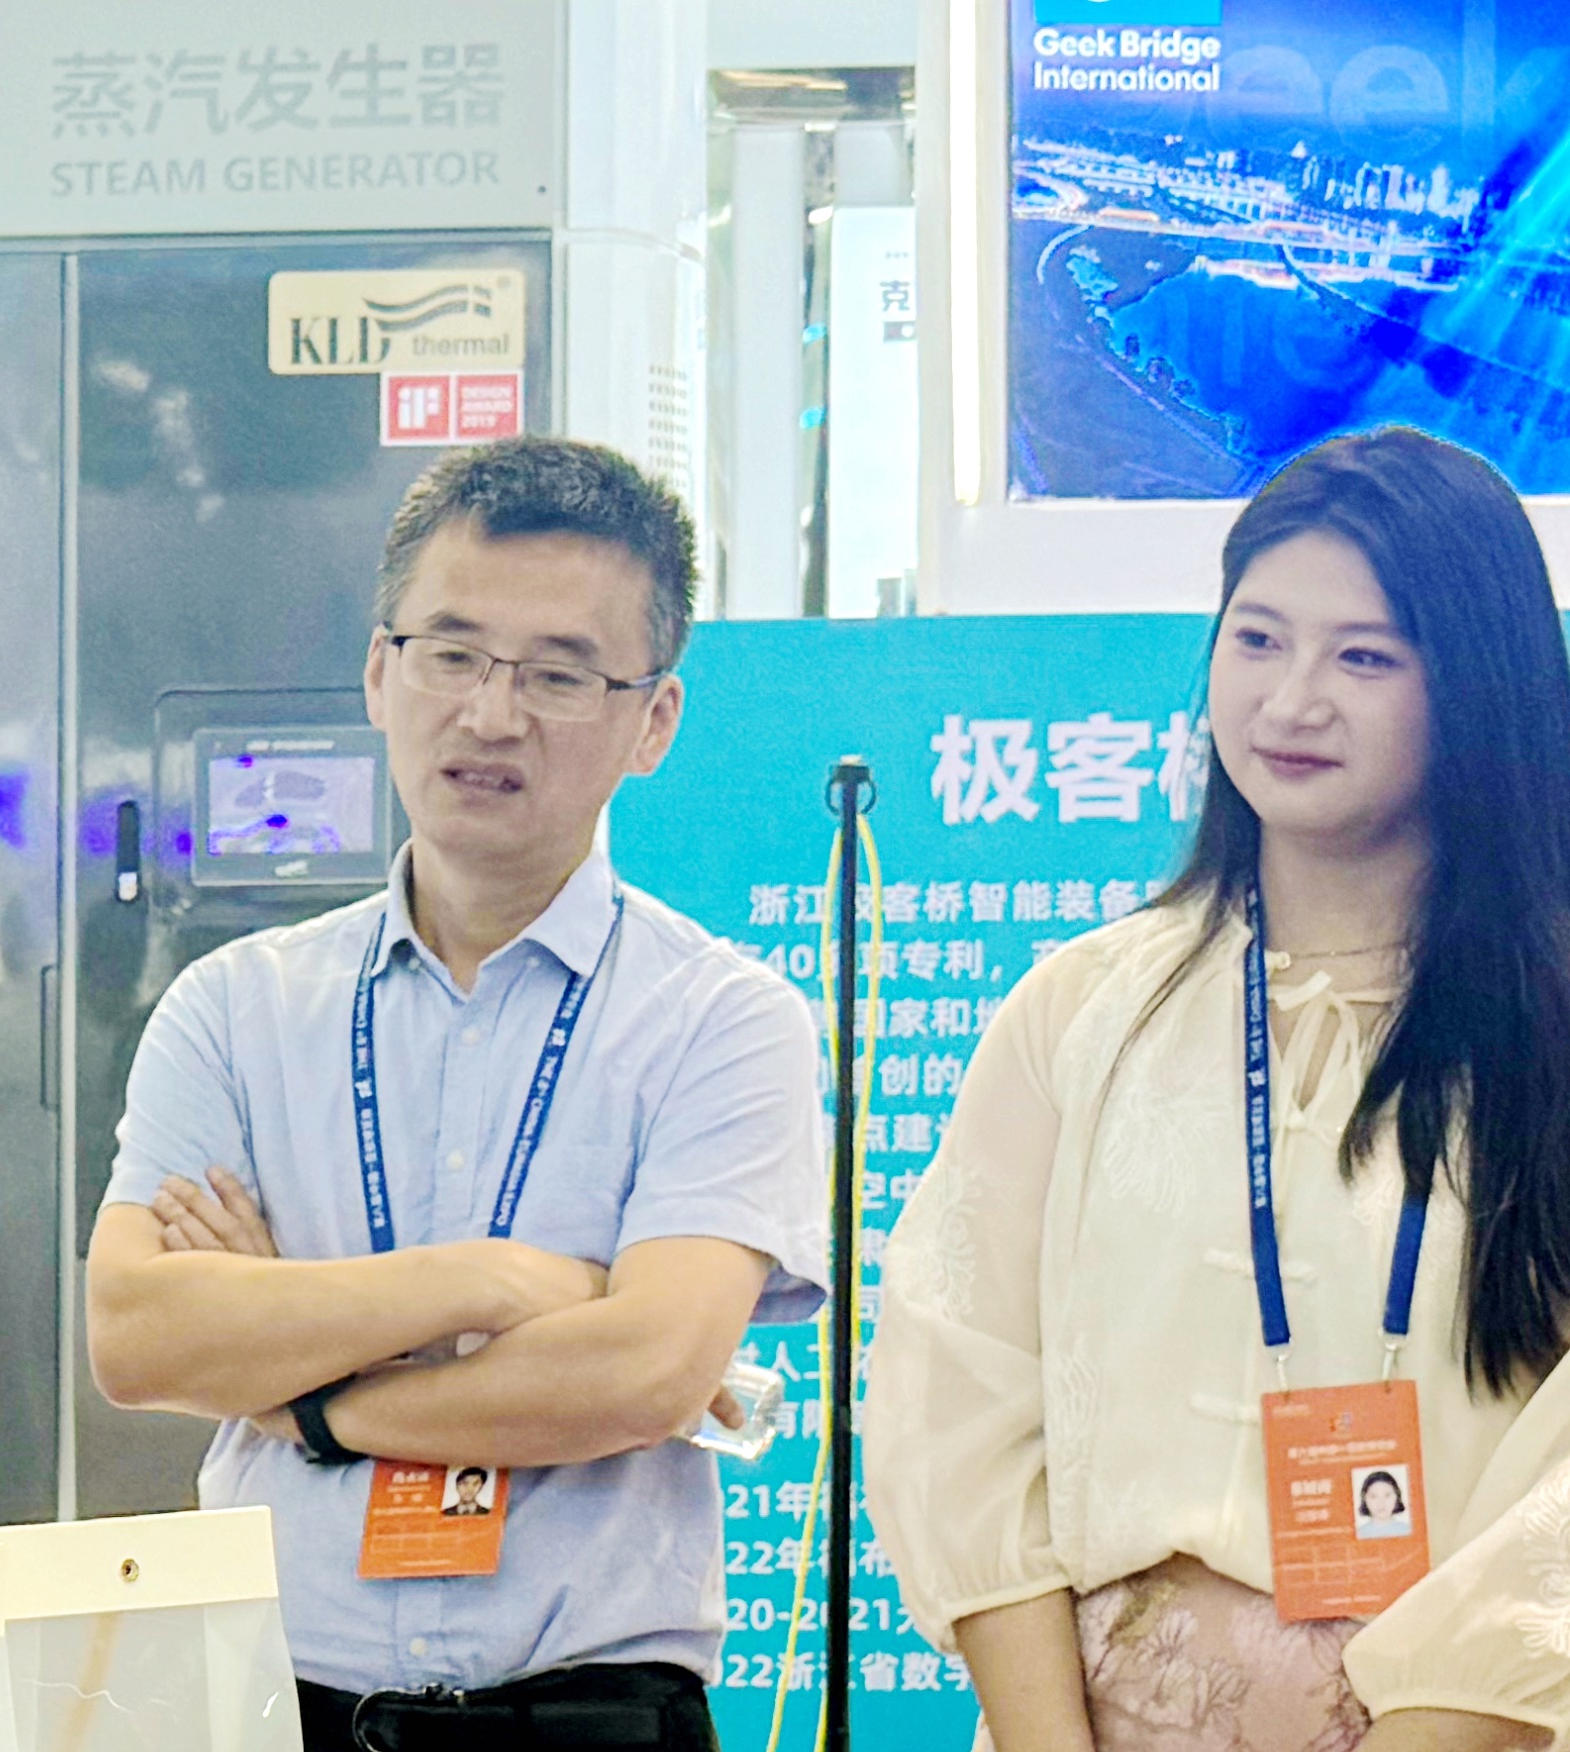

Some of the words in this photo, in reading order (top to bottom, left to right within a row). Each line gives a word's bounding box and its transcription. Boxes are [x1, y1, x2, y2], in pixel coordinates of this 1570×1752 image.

[1034, 28, 1116, 59] Geek
[1121, 29, 1221, 65] Bridge
[51, 43, 505, 139] 蒸汽发生器
[1034, 62, 1220, 92] International
[50, 157, 206, 198] STEAM
[223, 150, 501, 193] GENERATOR
[412, 333, 509, 357] thermal
